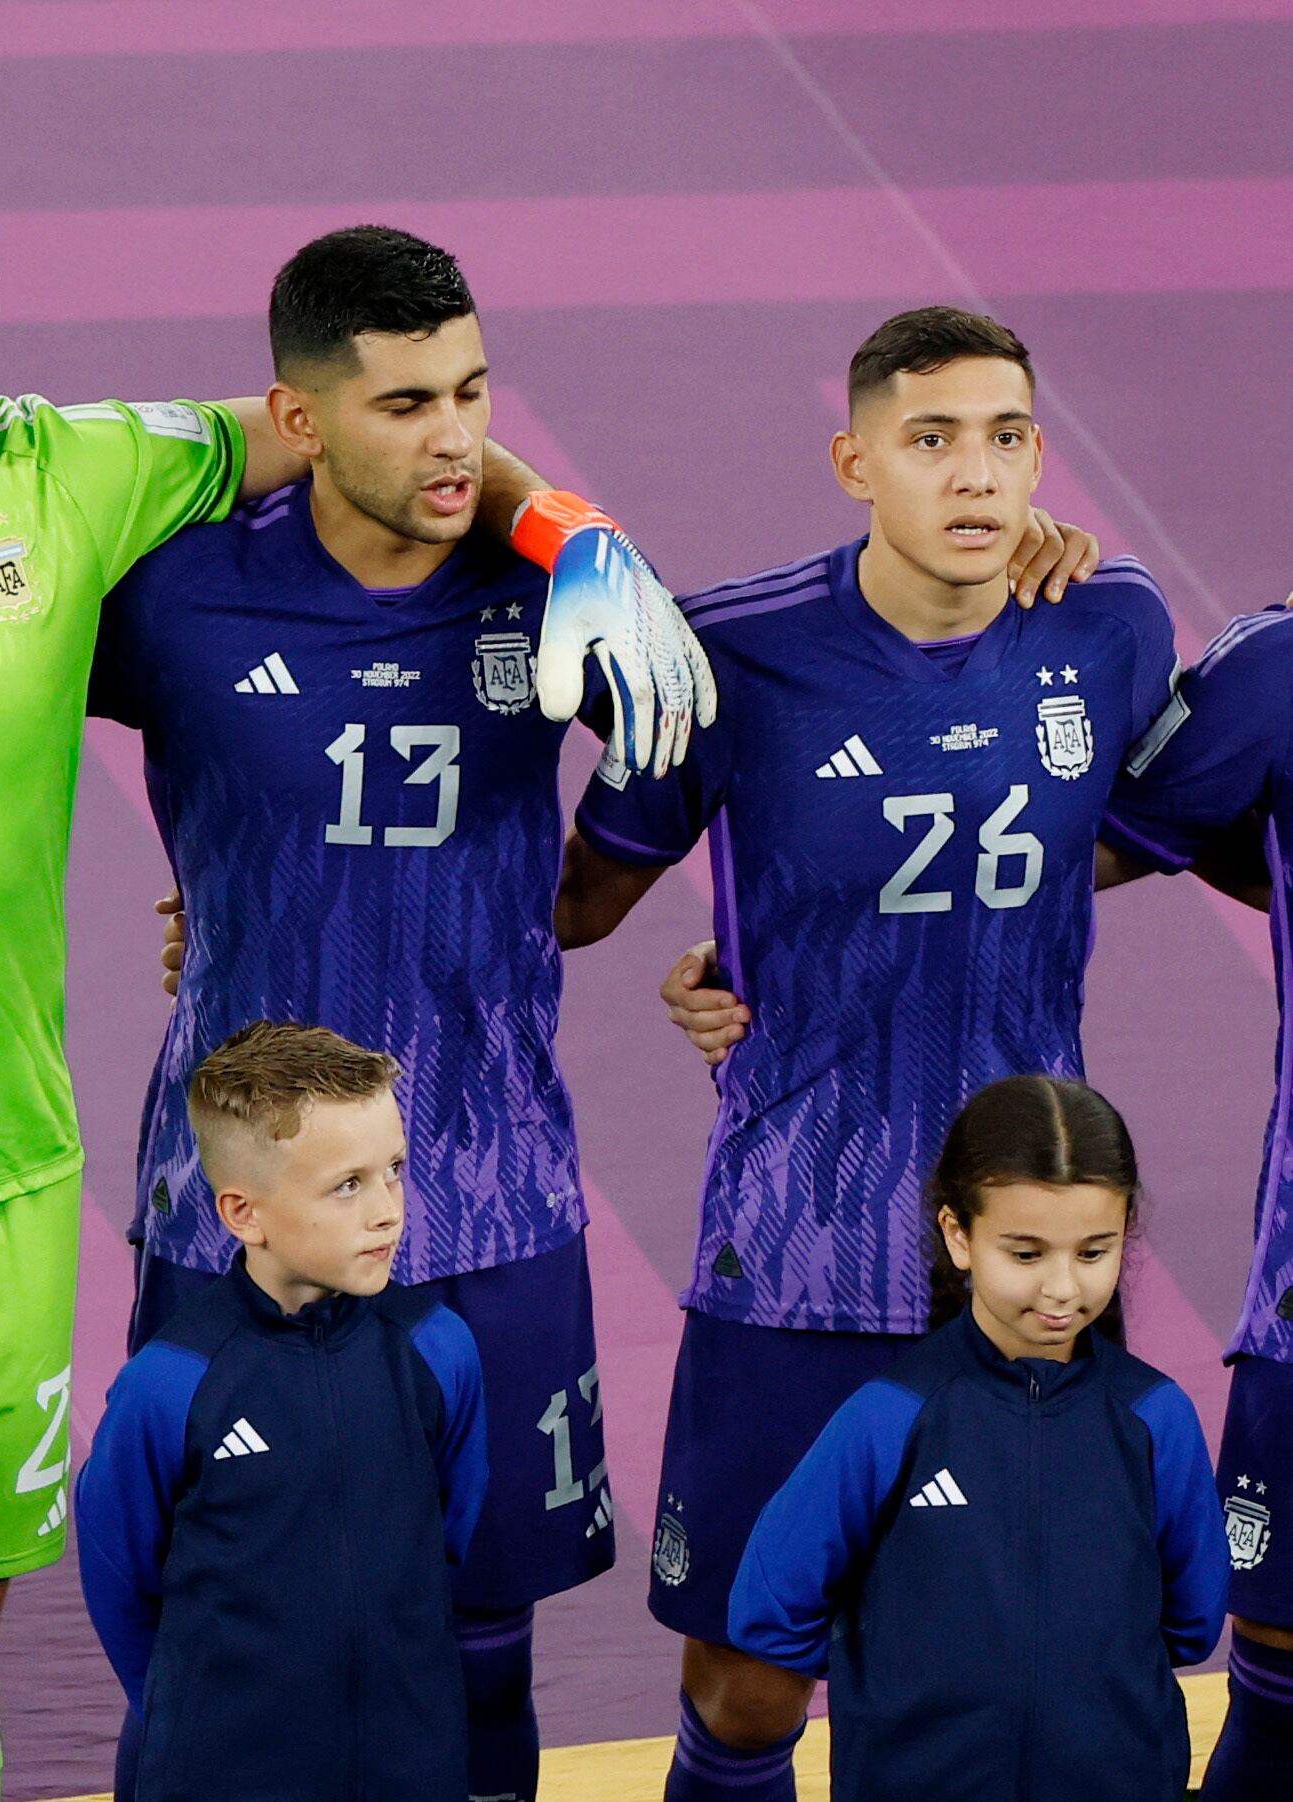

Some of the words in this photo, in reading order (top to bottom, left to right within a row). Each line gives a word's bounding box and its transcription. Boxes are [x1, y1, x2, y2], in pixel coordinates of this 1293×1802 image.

[490, 655, 524, 691] AFA
[324, 723, 460, 847] 13
[1053, 719, 1082, 755] AFA
[879, 784, 1044, 913] 26
[15, 1364, 71, 1494] 2
